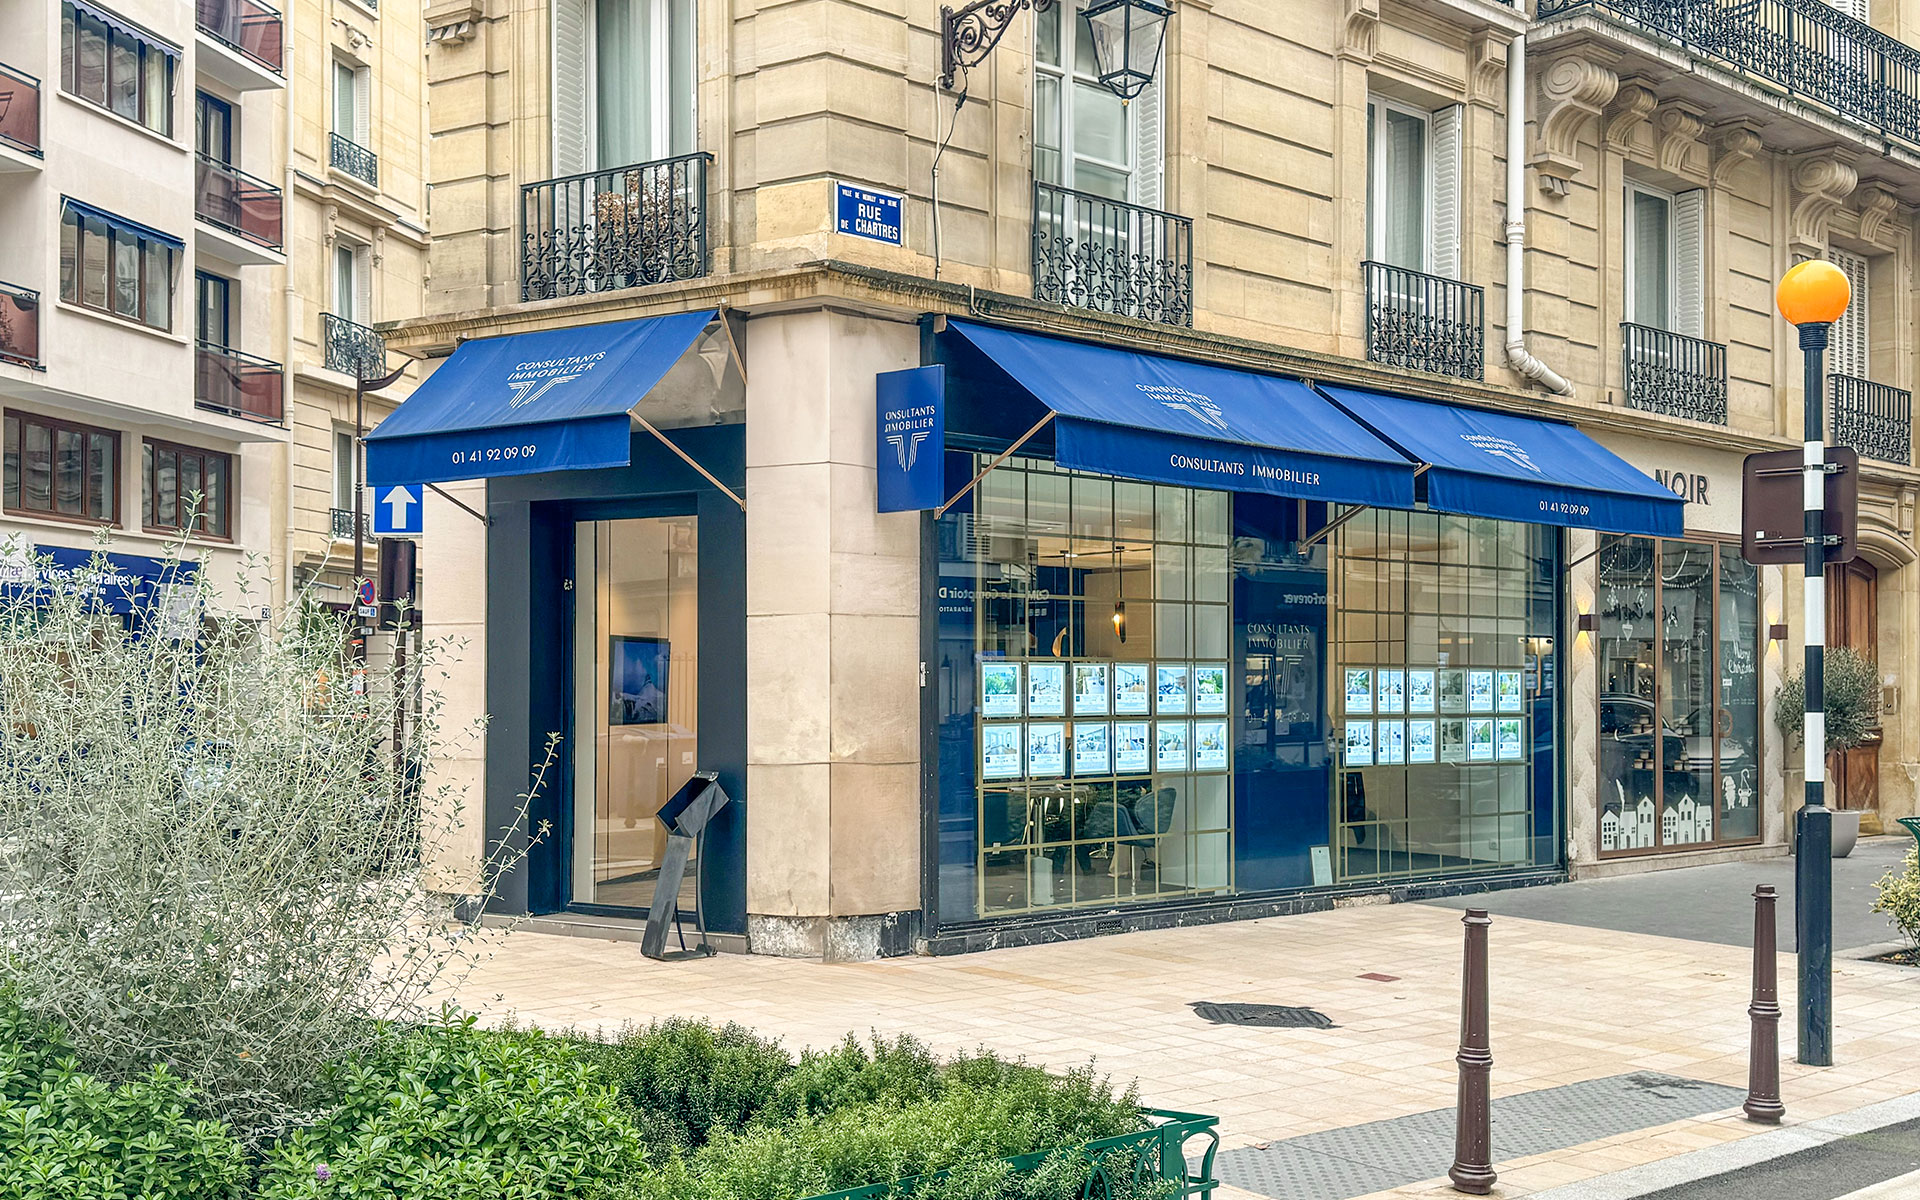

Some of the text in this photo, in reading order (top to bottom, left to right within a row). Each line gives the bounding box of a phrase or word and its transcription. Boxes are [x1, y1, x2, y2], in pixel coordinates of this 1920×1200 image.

[858, 203, 882, 221] RUE
[841, 218, 898, 239] DE CHARTRES
[515, 351, 607, 371] CONSULTANTS
[507, 362, 596, 381] IMMOBILIER
[1135, 383, 1213, 403] CONSULTANTS
[1145, 392, 1223, 411] IMMOBILIER
[885, 405, 936, 421] ONSULTANTS
[452, 444, 537, 464] 01 41 92 09 09
[1170, 454, 1321, 486] CONSULTANTS IMMOBILIER
[1655, 468, 1711, 506] NOIR
[1539, 500, 1590, 516] 01 41 92 09 09
[1247, 622, 1311, 636] CONSULTANTS
[1248, 638, 1309, 650] IMMOBILIER
